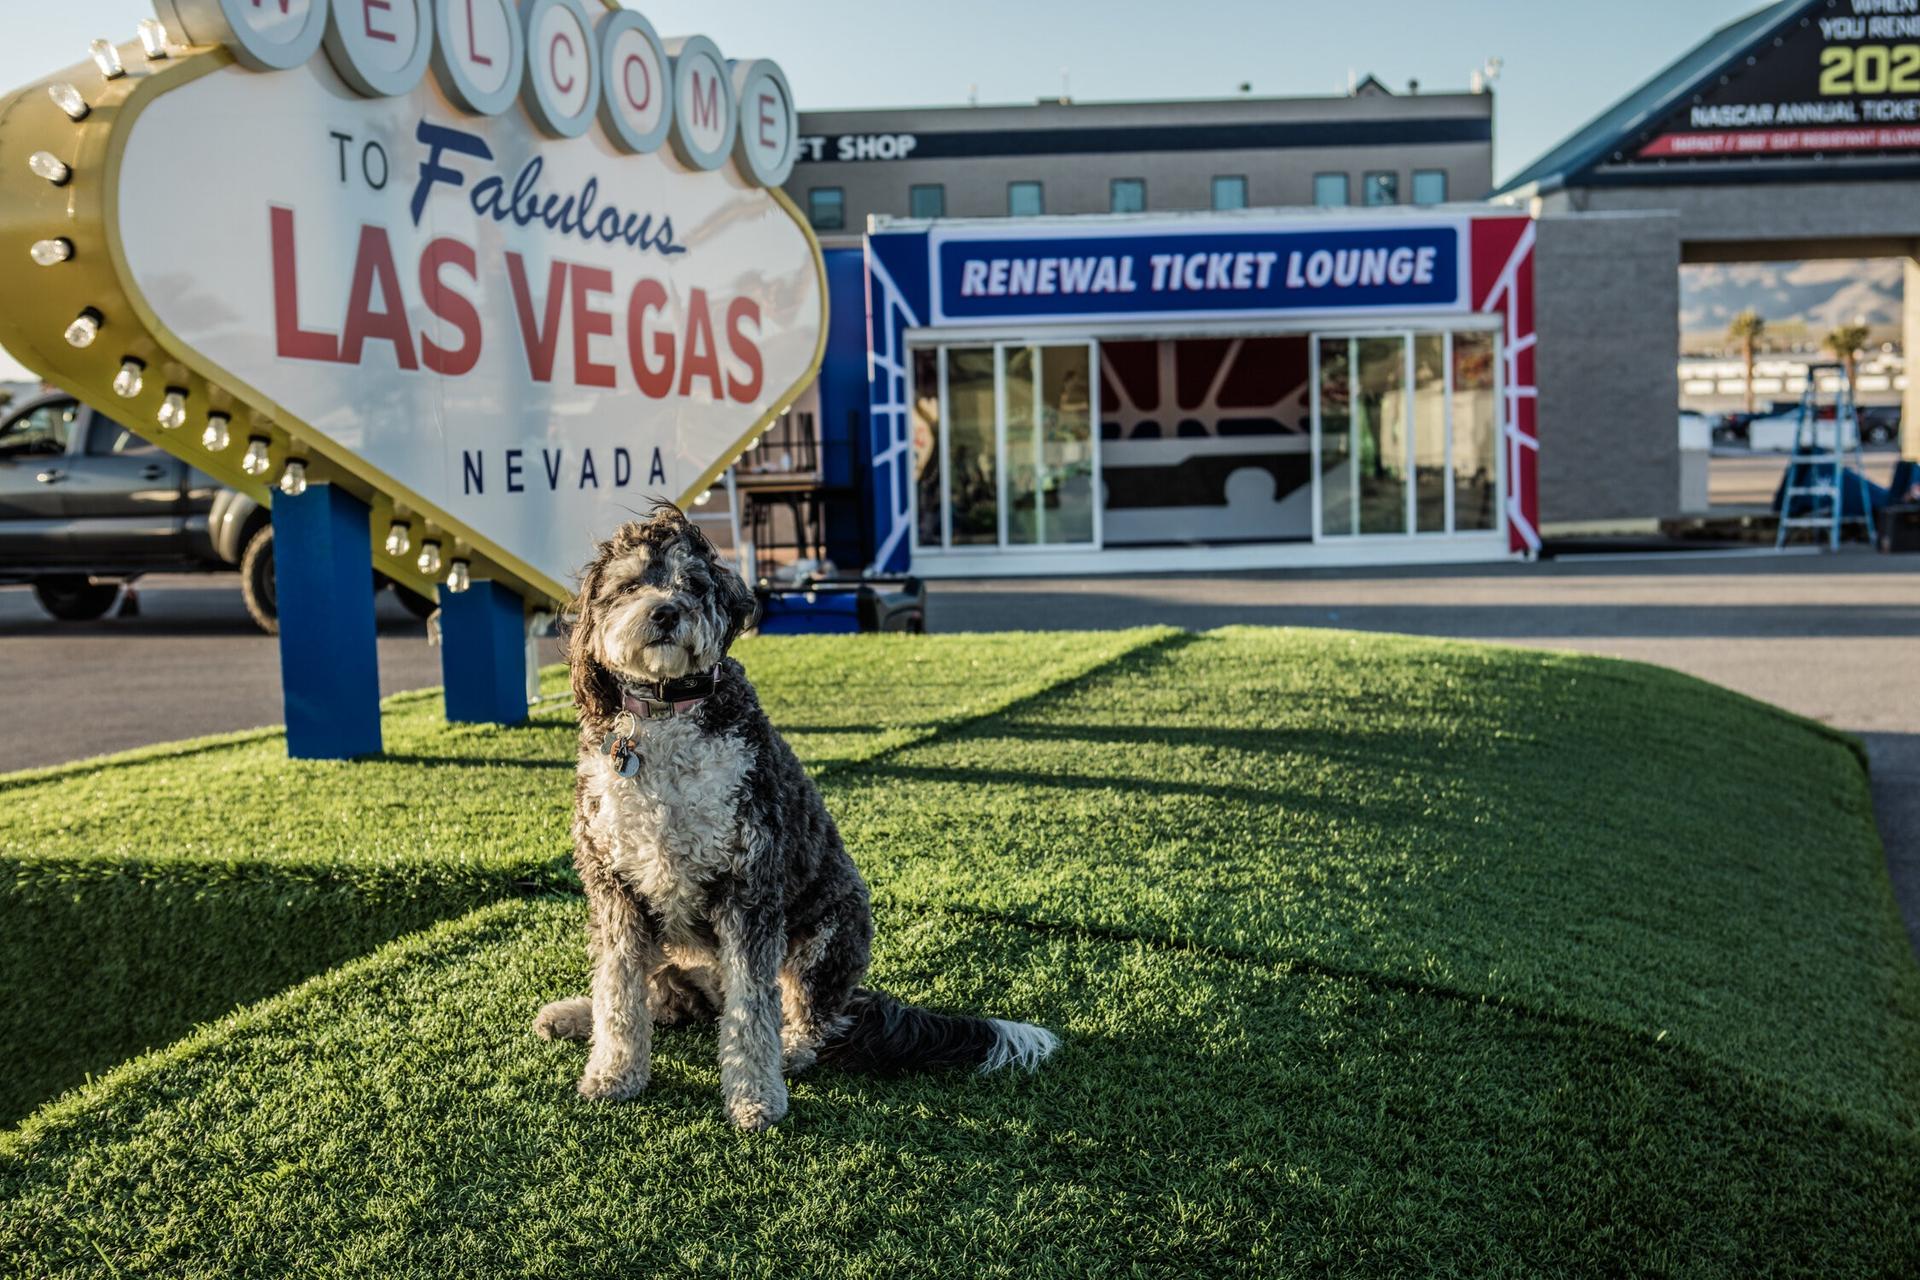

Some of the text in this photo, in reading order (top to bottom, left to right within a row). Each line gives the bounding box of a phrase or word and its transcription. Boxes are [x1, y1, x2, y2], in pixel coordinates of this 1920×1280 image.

[1819, 16, 1866, 40] YOU
[252, 0, 788, 149] ELCOME
[1690, 104, 1774, 127] NASCAR
[1775, 101, 1859, 124] ANNUAL
[837, 134, 917, 160] SHOP
[330, 119, 686, 255] TO Fabulous
[961, 247, 1436, 296] RENEWAL TICKET LOUNGE
[270, 206, 764, 404] LAS VEGAS
[462, 446, 667, 495] NEVADA
